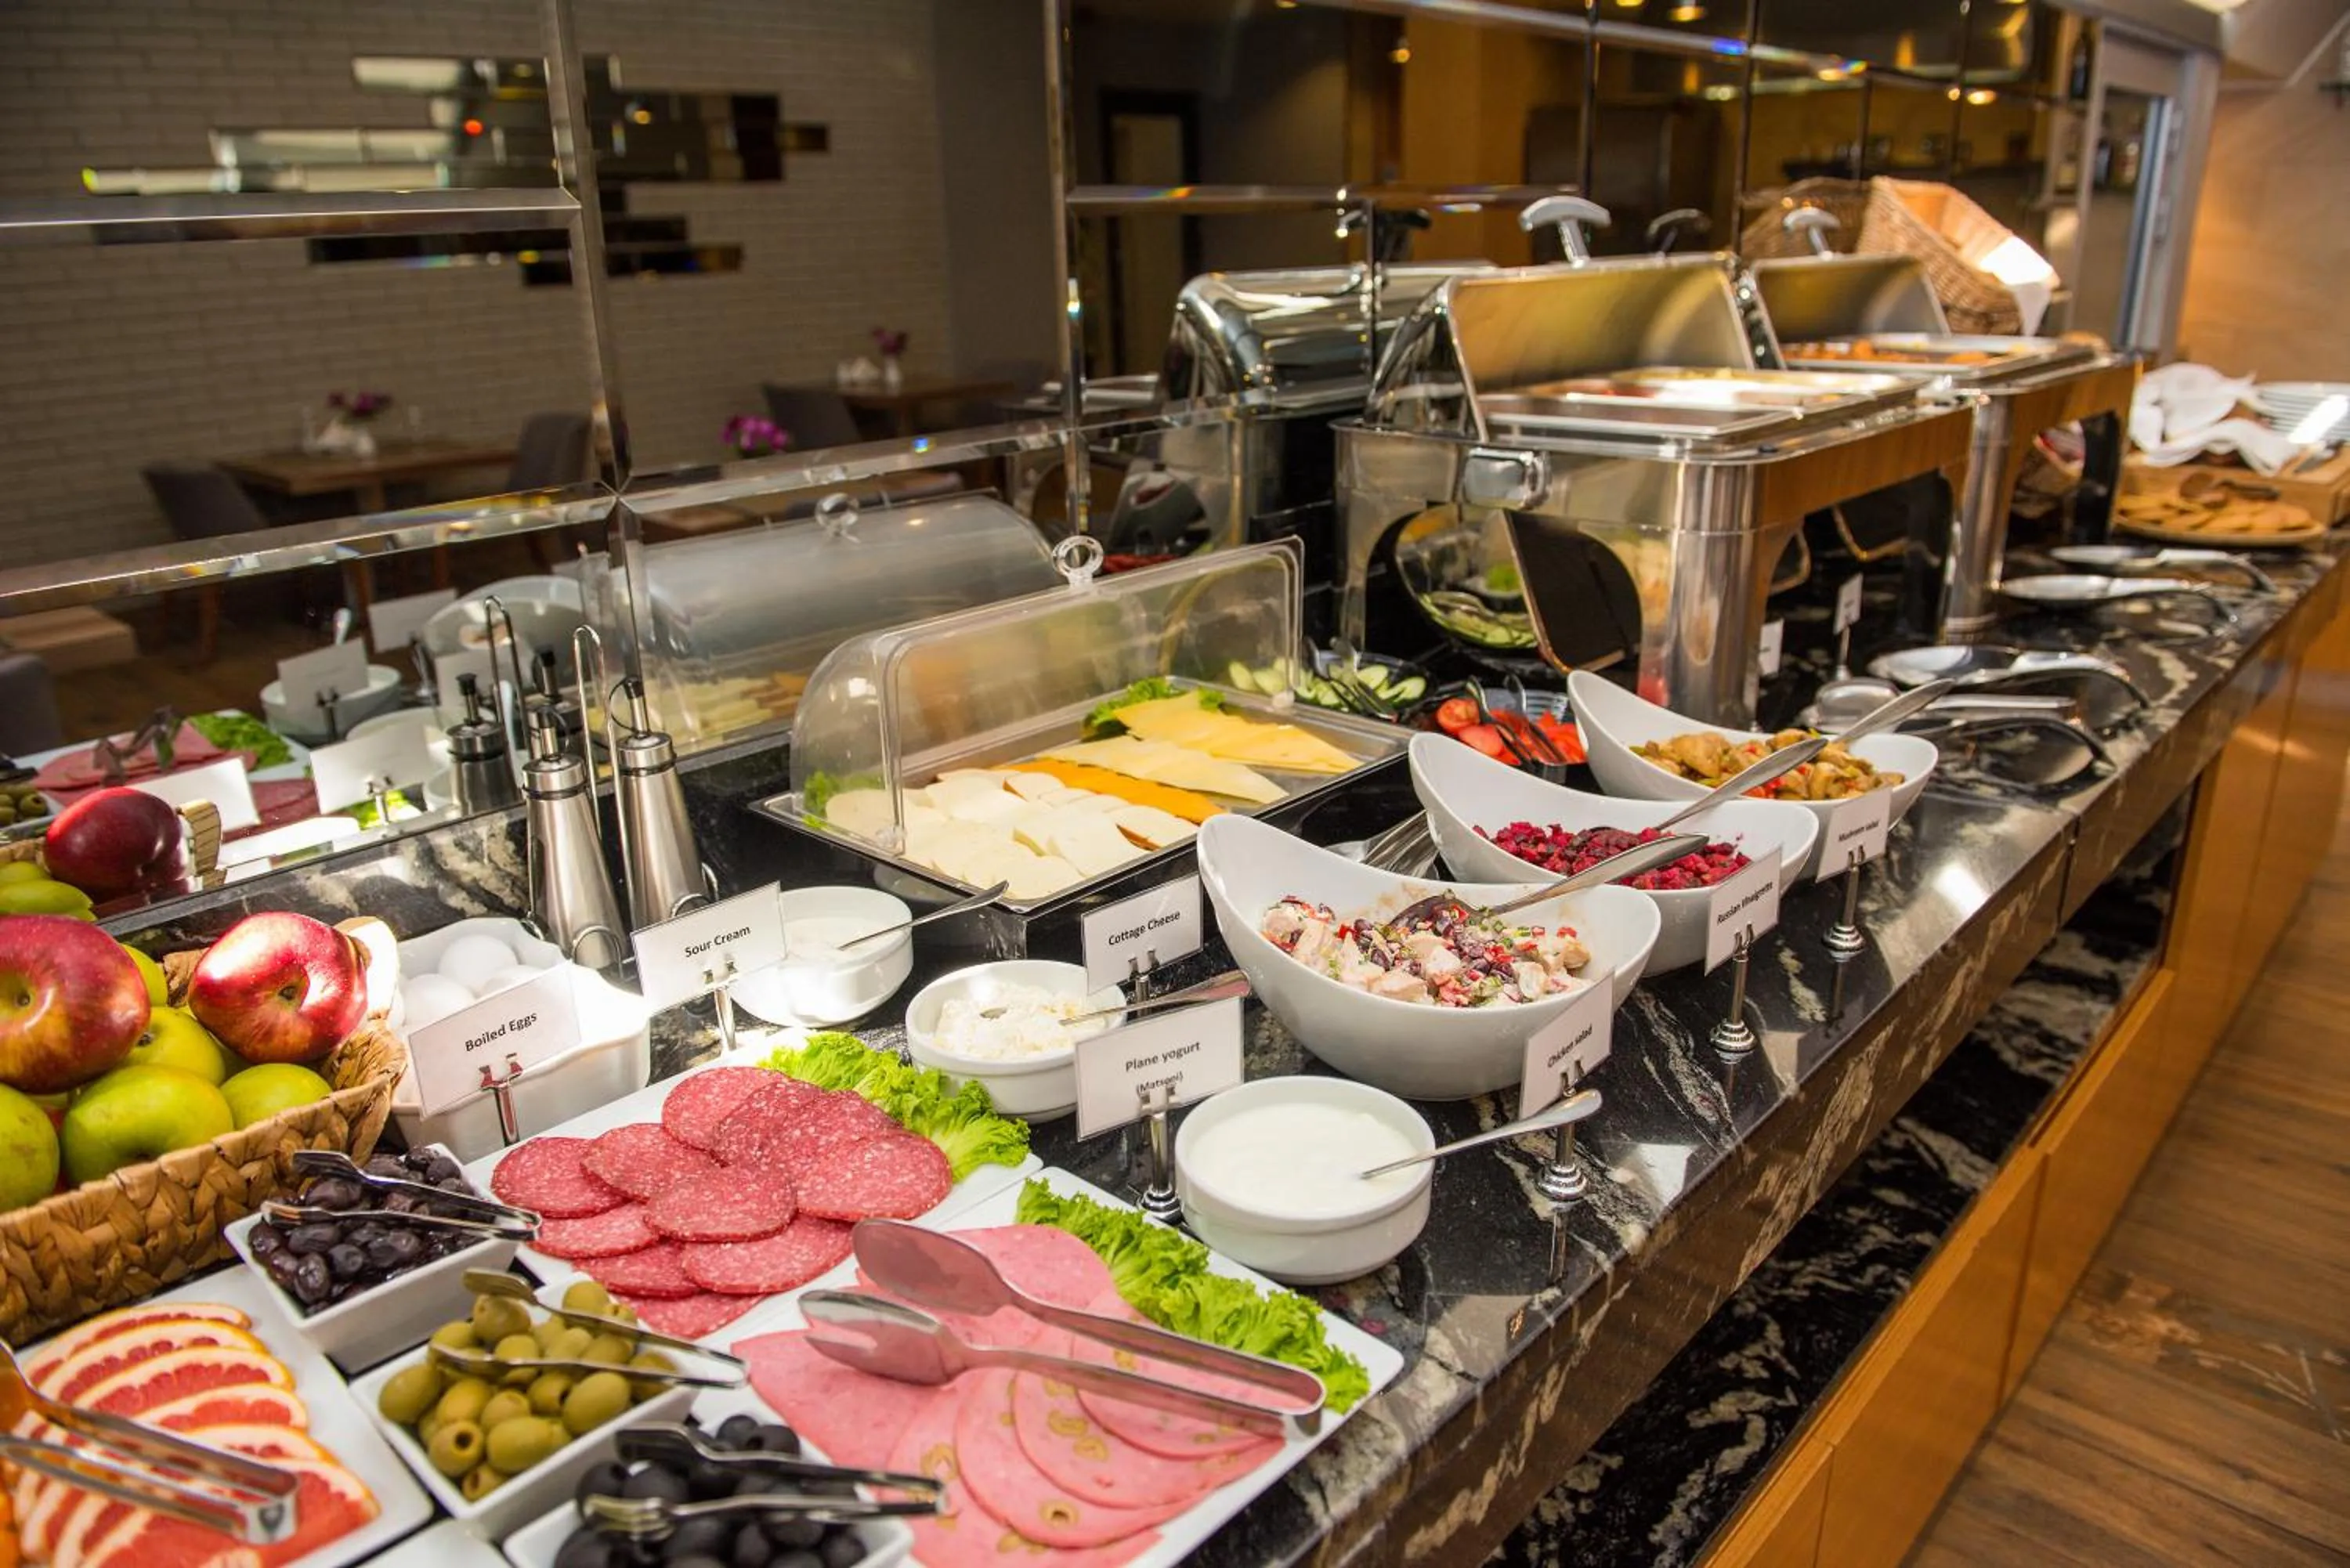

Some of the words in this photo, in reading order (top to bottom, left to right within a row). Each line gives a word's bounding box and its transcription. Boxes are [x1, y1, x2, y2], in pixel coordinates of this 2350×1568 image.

[1108, 924, 1145, 945] Cottage
[1148, 912, 1180, 929] Cheese
[1717, 903, 1741, 924] Russian
[685, 940, 711, 957] Sour
[714, 927, 751, 945] Cream
[465, 1024, 506, 1052] Boiled
[509, 1013, 537, 1031] Eggs
[1126, 1056, 1159, 1072] Plane
[1162, 1042, 1200, 1063] yogurt
